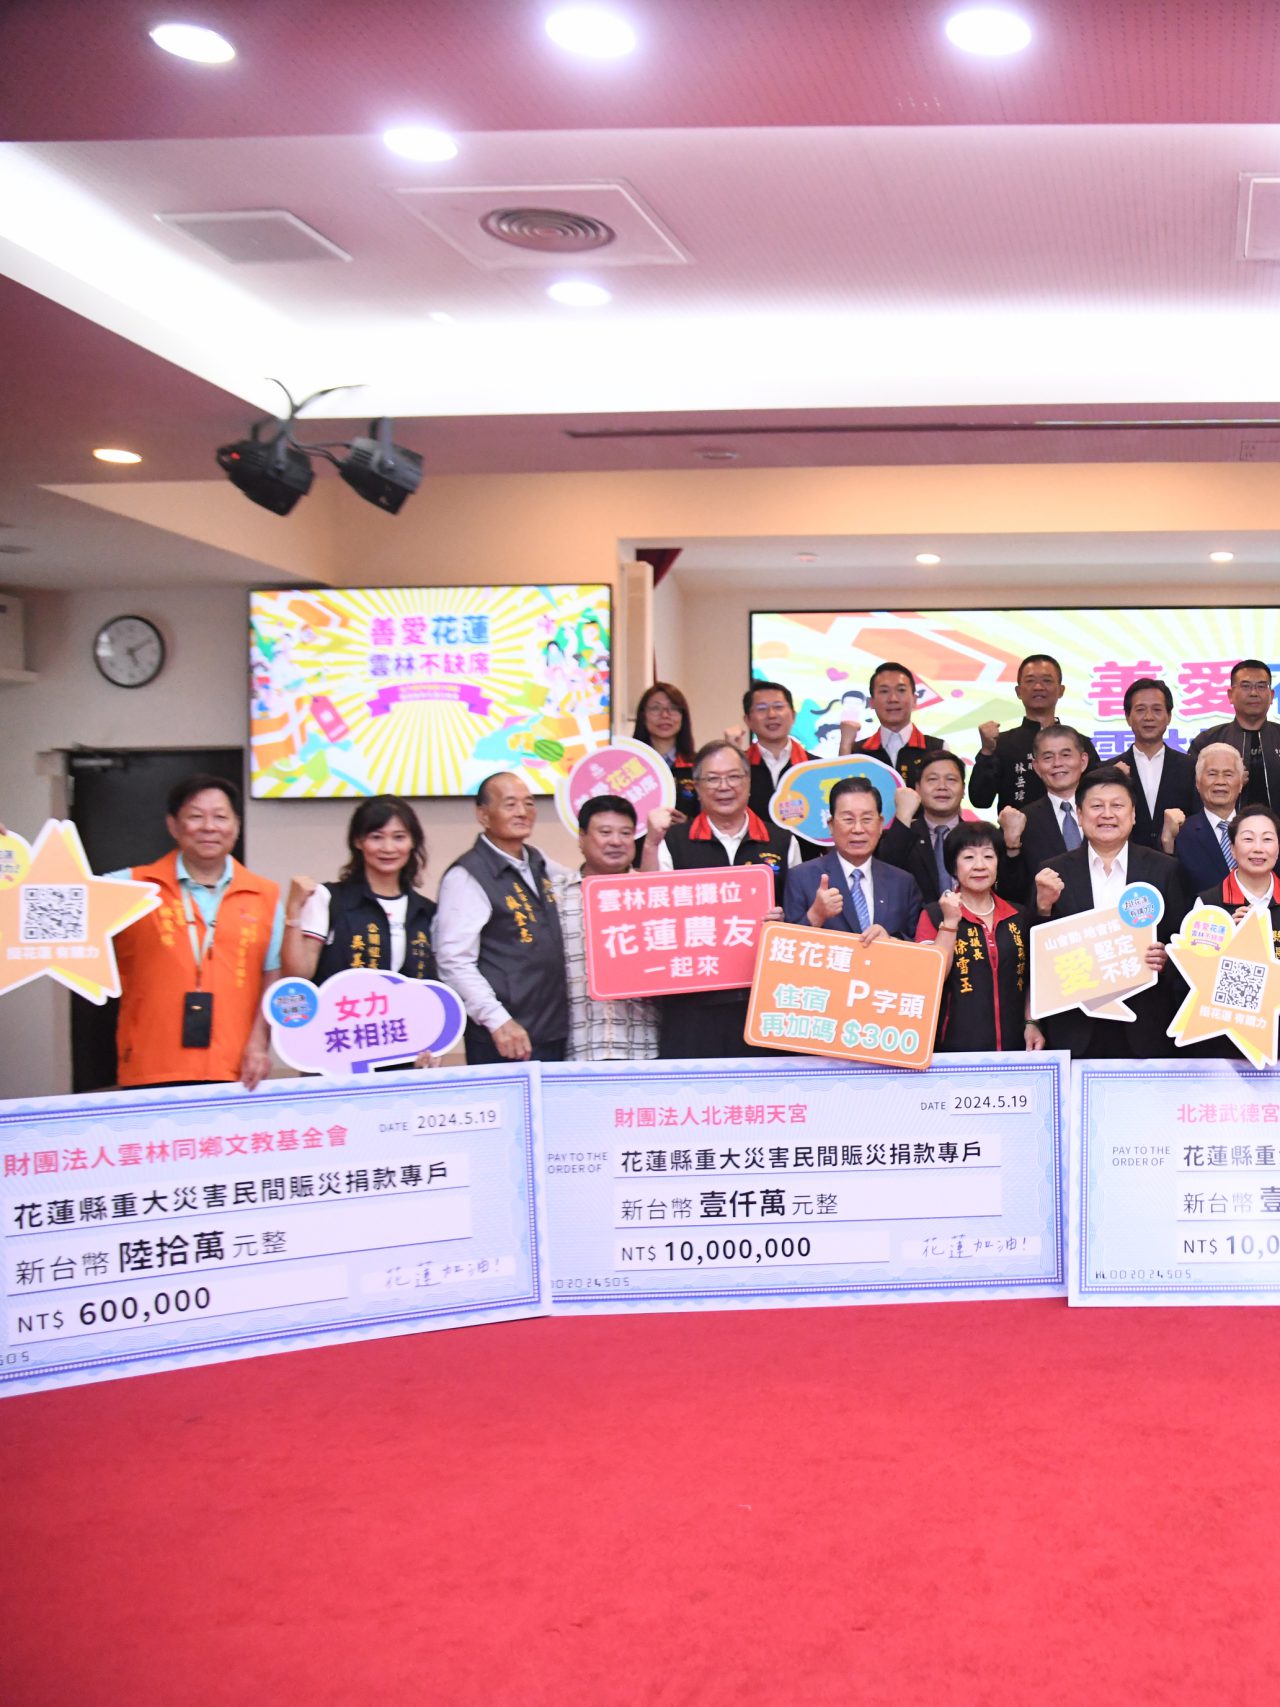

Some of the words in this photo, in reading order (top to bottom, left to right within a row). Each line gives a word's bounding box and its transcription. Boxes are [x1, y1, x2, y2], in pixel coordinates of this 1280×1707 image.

[371, 615, 489, 645] 善愛花蓮
[370, 653, 489, 676] 雲林不缺席
[601, 915, 756, 959] 花蓮農友
[967, 926, 984, 960] 副議長
[1094, 935, 1136, 961] 堅定
[644, 955, 719, 978] 一起來
[955, 939, 974, 993] 徐雪玉
[1055, 946, 1099, 996] 愛
[1101, 957, 1141, 983] 不移
[335, 992, 388, 1022] 女力
[773, 984, 830, 1012] 住宿
[325, 1018, 408, 1053] 來相挺
[760, 1013, 837, 1043] 再加碼
[841, 1019, 919, 1054] $300
[614, 1104, 808, 1128] 財團法人北港朝天宮
[921, 1101, 946, 1111] DATE
[954, 1094, 1028, 1110] 2024.5.19
[1177, 1103, 1280, 1124] 北港武德宮
[379, 1121, 408, 1133] DATE
[417, 1109, 497, 1129] 2024.5.19
[3, 1124, 349, 1177] 財團法人雲林同鄉文教基金會
[547, 1153, 567, 1161] PAY
[569, 1152, 584, 1161] TO
[587, 1152, 608, 1161] THE
[621, 1140, 982, 1174] 花蓮縣重大災害民間賑災捐款專戶
[1112, 1146, 1131, 1154] PAY
[1134, 1146, 1147, 1154] TO
[1150, 1146, 1171, 1154] THE
[1112, 1157, 1148, 1166] ORDER
[1151, 1157, 1164, 1166] OF
[547, 1164, 585, 1174] ORDER
[588, 1163, 602, 1173] OF
[14, 1162, 449, 1230] 花蓮縣重大災害民間賑災捐款專戶
[621, 1245, 656, 1263] NT$
[664, 1236, 812, 1265] 10,000,000
[1183, 1237, 1218, 1256] NT$
[17, 1310, 65, 1334] NT$
[79, 1286, 211, 1328] 600,000
